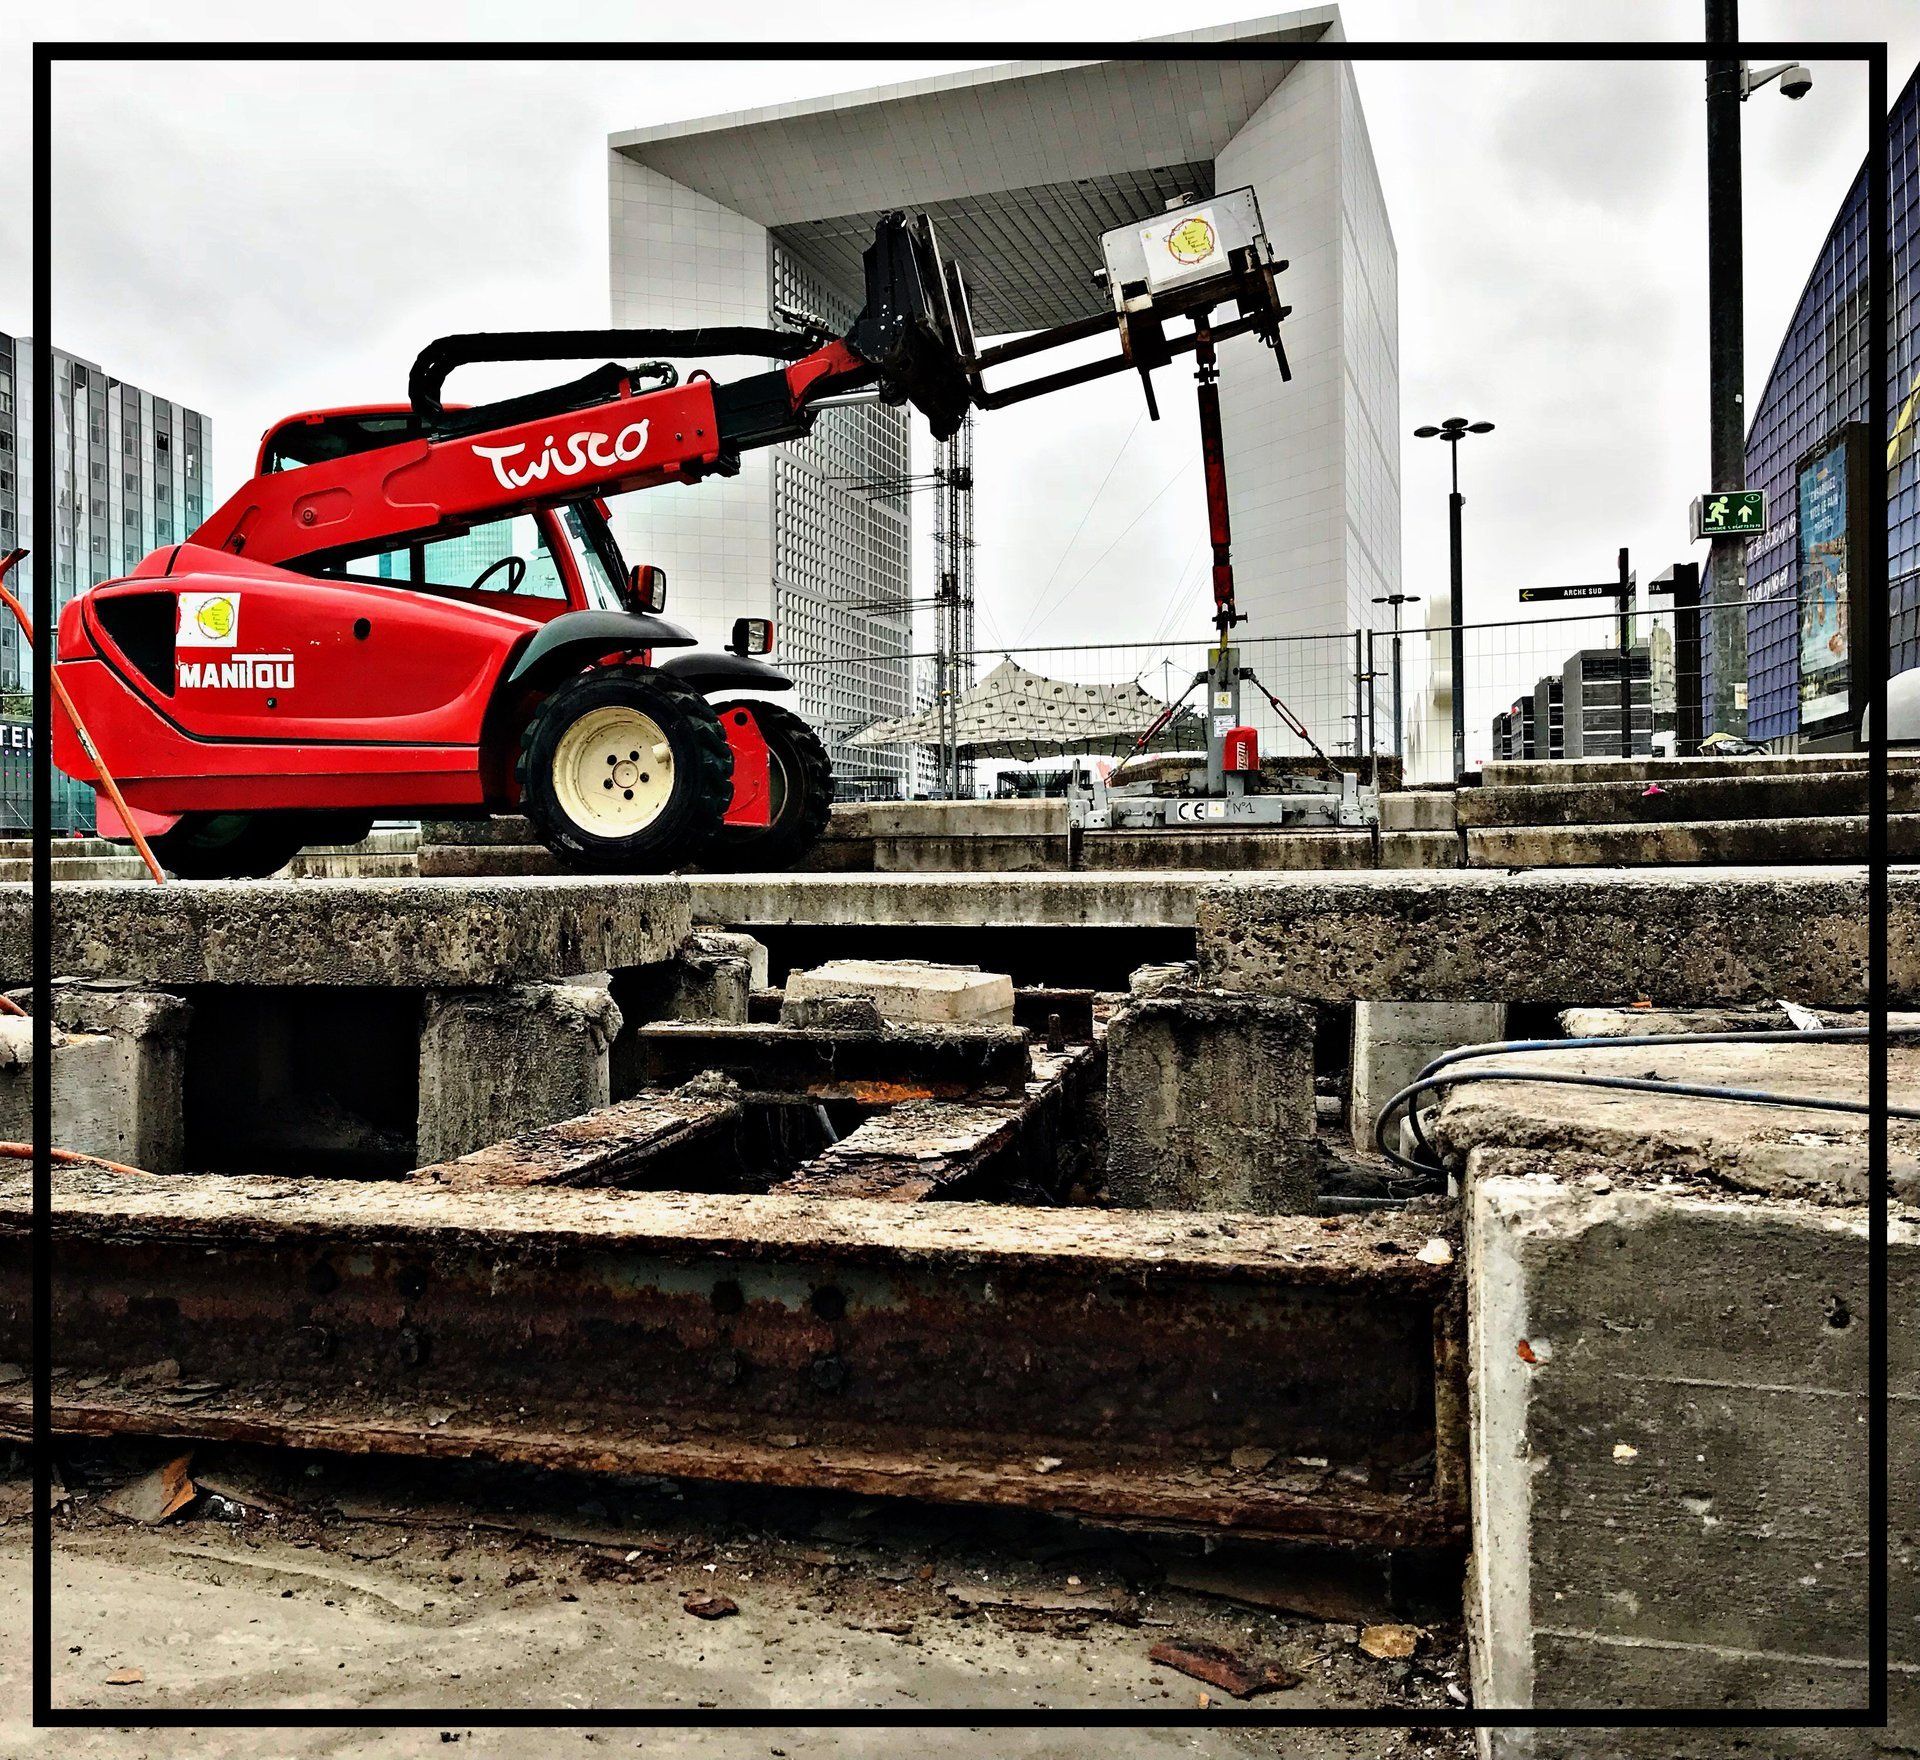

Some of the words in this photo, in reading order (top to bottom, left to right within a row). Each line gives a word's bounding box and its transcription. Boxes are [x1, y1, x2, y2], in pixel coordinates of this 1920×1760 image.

[471, 418, 650, 490] Twisco
[1564, 588, 1587, 596] ARCHE
[1588, 587, 1602, 595] SUD
[179, 653, 295, 689] MANITOU
[1178, 802, 1205, 820] CE
